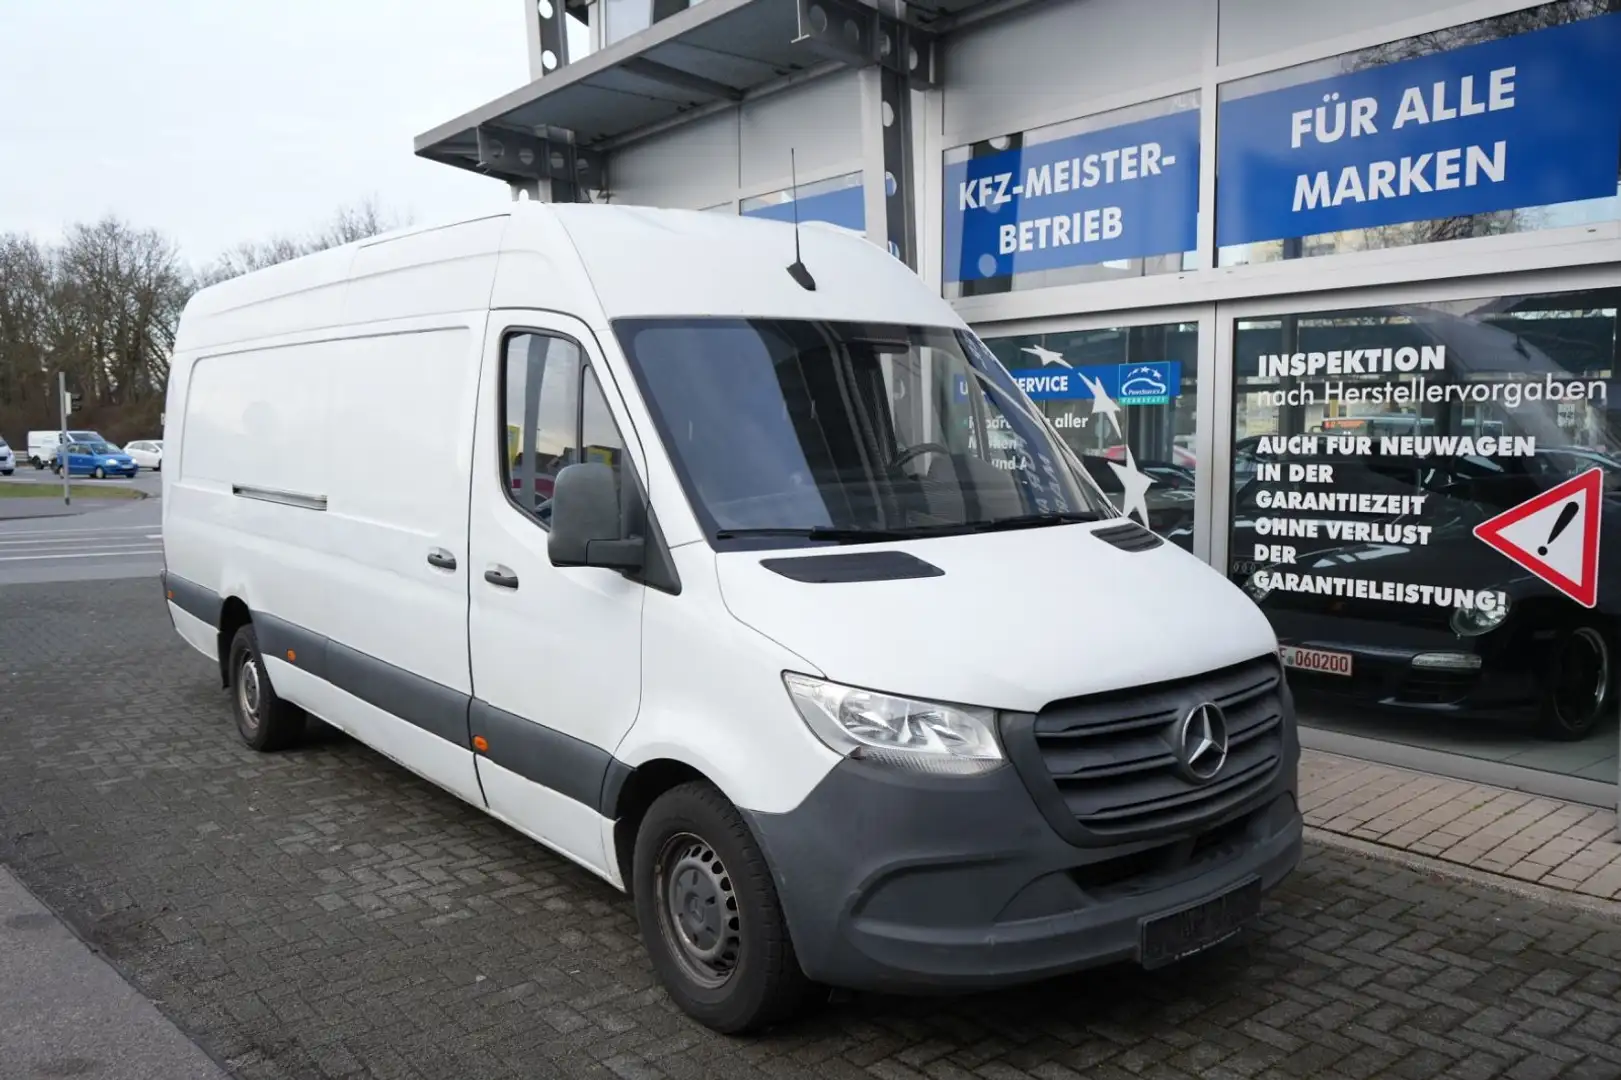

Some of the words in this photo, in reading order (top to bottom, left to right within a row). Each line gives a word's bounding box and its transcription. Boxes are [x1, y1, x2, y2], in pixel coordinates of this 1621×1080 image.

[1291, 92, 1378, 149] FÜR
[1392, 66, 1516, 130] ALLE
[959, 142, 1177, 212] KFZ-MEISTER-
[1292, 140, 1506, 212] MARKEN
[999, 206, 1123, 255] BETRIEB
[1258, 345, 1446, 378] INSPEKTION
[1257, 382, 1314, 407] nach
[1324, 372, 1607, 408] Herstellervorgaben
[1054, 412, 1089, 428] aller
[1256, 436, 1317, 455] AUCH
[1326, 435, 1372, 455] FÜR
[1381, 436, 1536, 457] NEUWAGEN
[1257, 464, 1281, 482] IN
[1288, 464, 1334, 483] DER
[1255, 489, 1426, 515] GARANTIEZEIT
[1255, 516, 1319, 538] OHNE
[1324, 520, 1432, 546] VERLUST
[1253, 543, 1297, 565] DER
[1253, 570, 1507, 614] GARANTIELEISTUNG!
[1295, 649, 1349, 673] 060200
